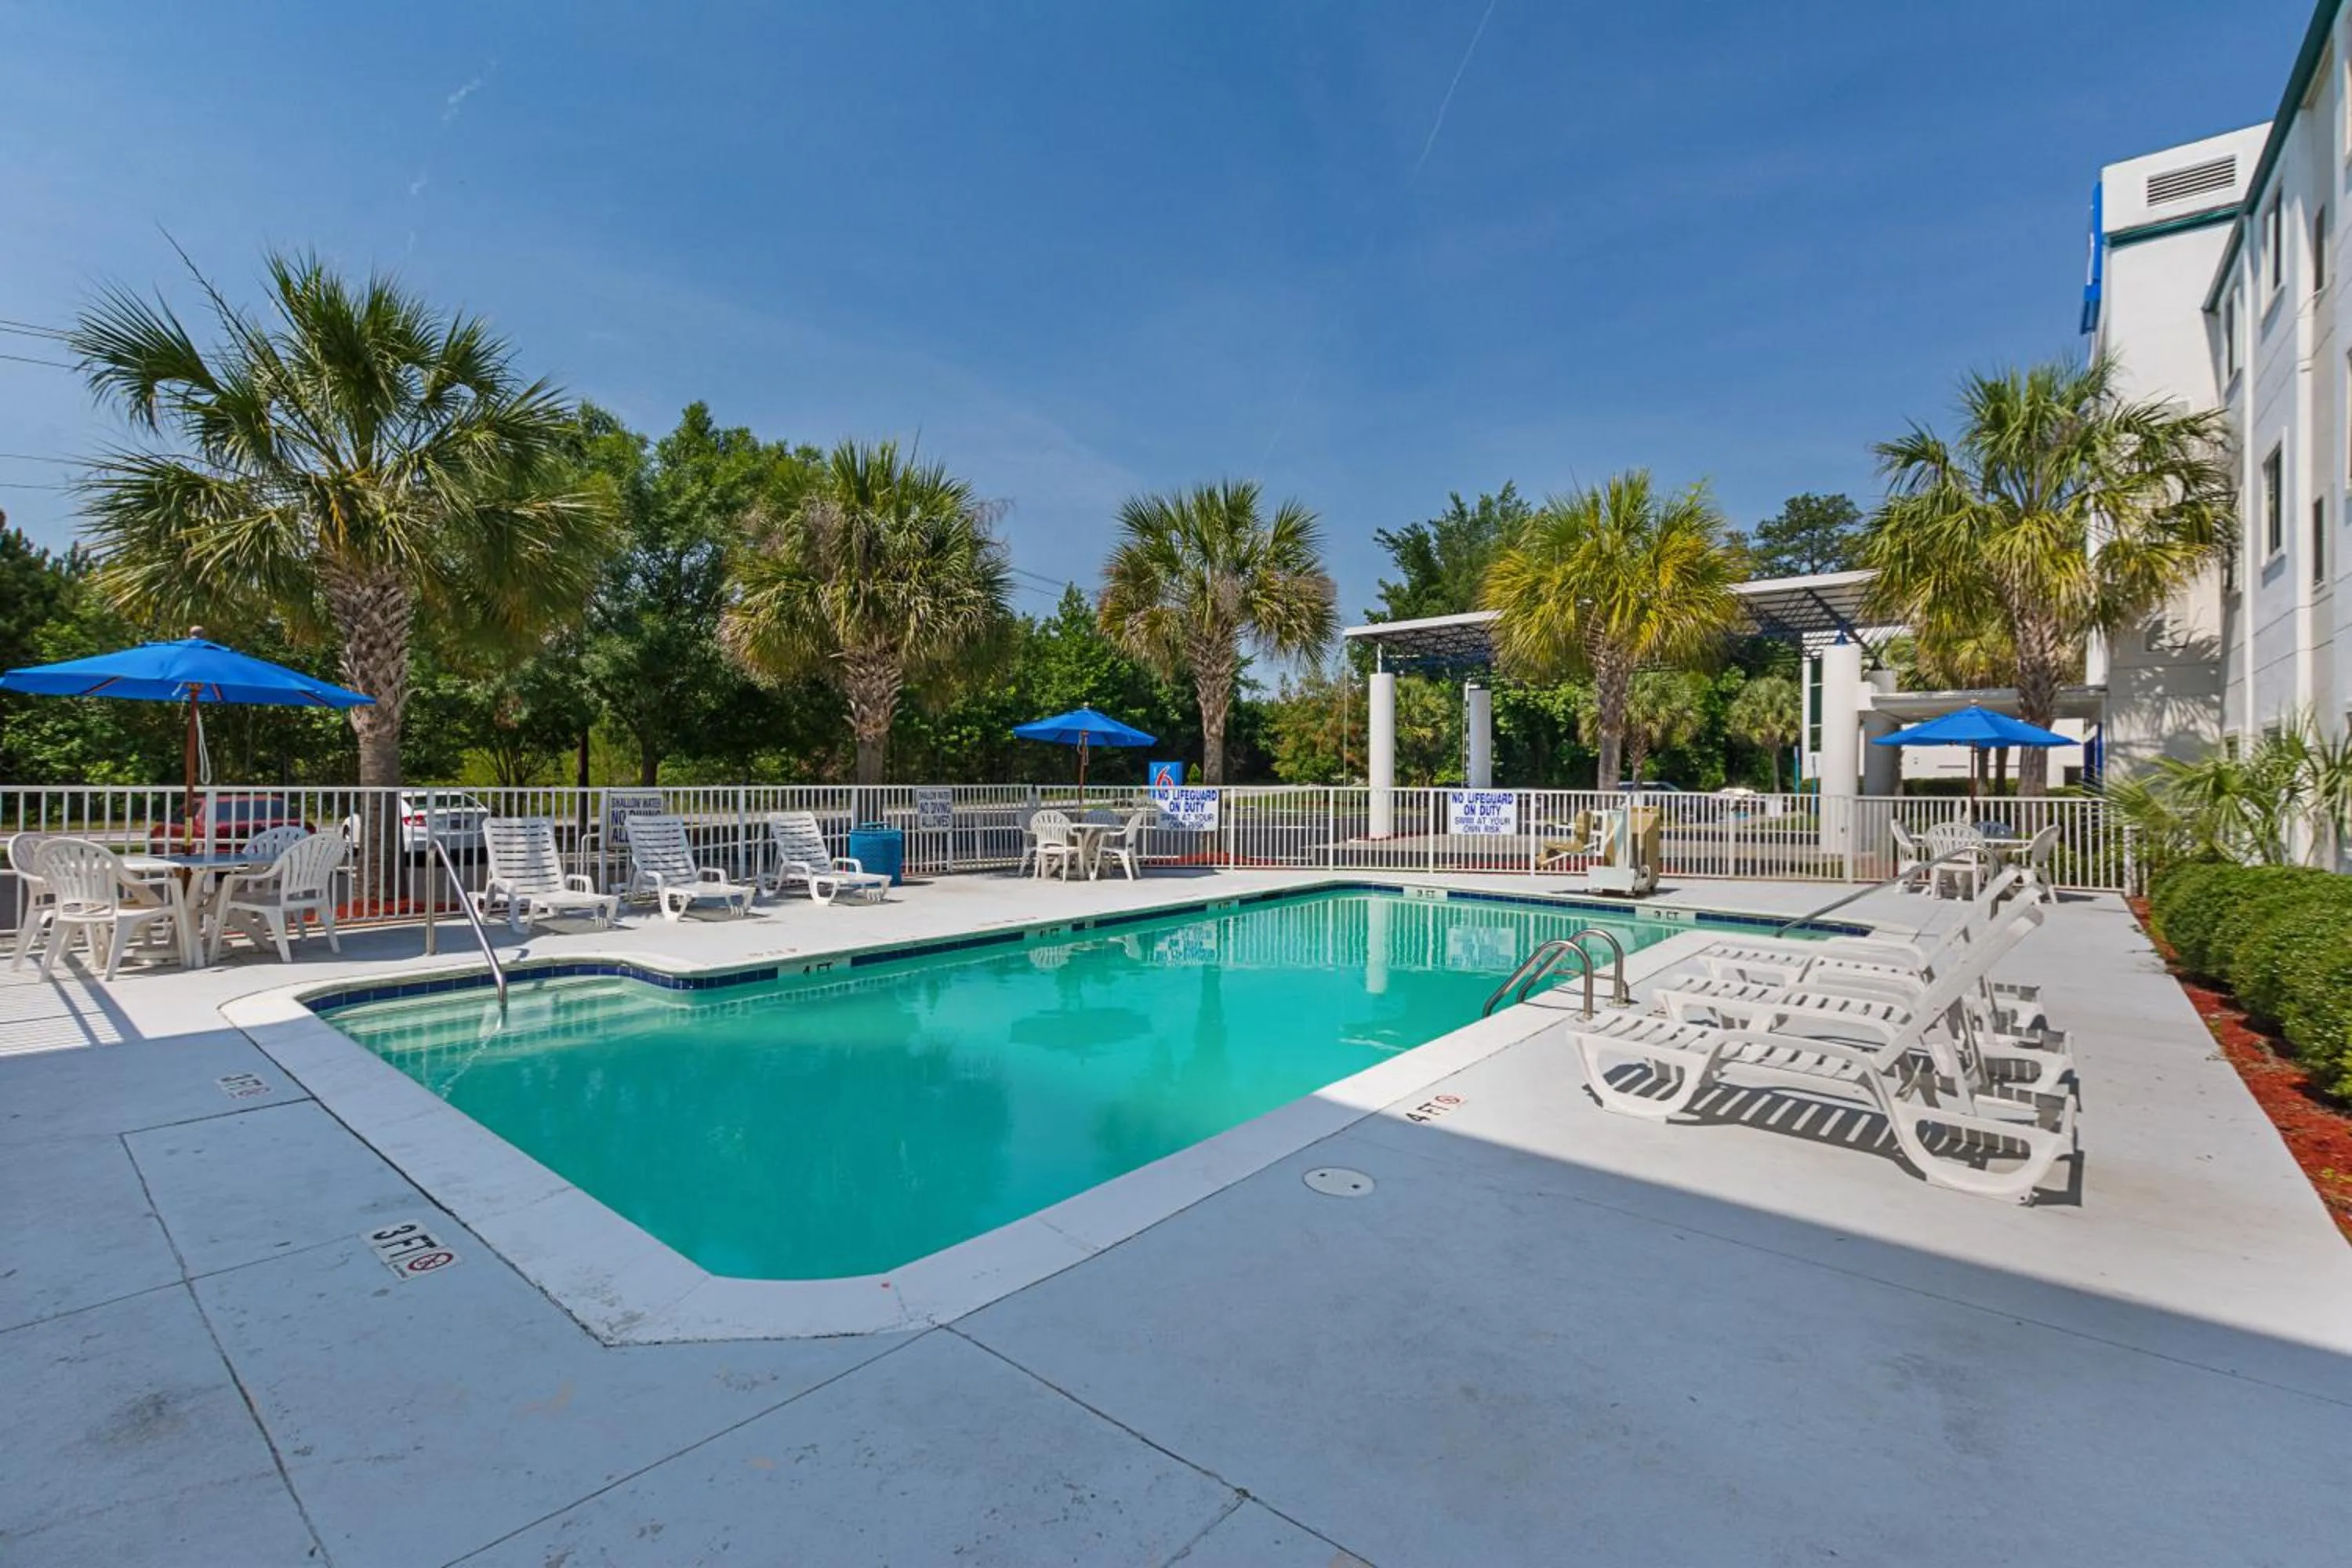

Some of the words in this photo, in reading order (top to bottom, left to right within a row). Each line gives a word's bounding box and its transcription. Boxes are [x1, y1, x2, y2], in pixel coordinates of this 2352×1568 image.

[1158, 789, 1169, 800] NO
[1172, 789, 1218, 801] LIFEGUARD
[1452, 792, 1464, 804] NO
[1468, 792, 1514, 804] LIFEGUARD
[612, 798, 641, 808] SHALLOW
[642, 798, 662, 808] WATER
[920, 802, 929, 815] NO
[931, 802, 951, 815] DIVING
[1169, 801, 1180, 812] ON
[1185, 801, 1205, 812] DUTY
[1464, 804, 1476, 816] ON
[1480, 804, 1501, 816] DUTY
[612, 810, 626, 826] NO
[921, 815, 950, 829] ALLOWED
[1415, 1102, 1450, 1116] FT
[1404, 1112, 1431, 1122] 4
[372, 1224, 417, 1240] 3
[379, 1233, 438, 1258] FT
